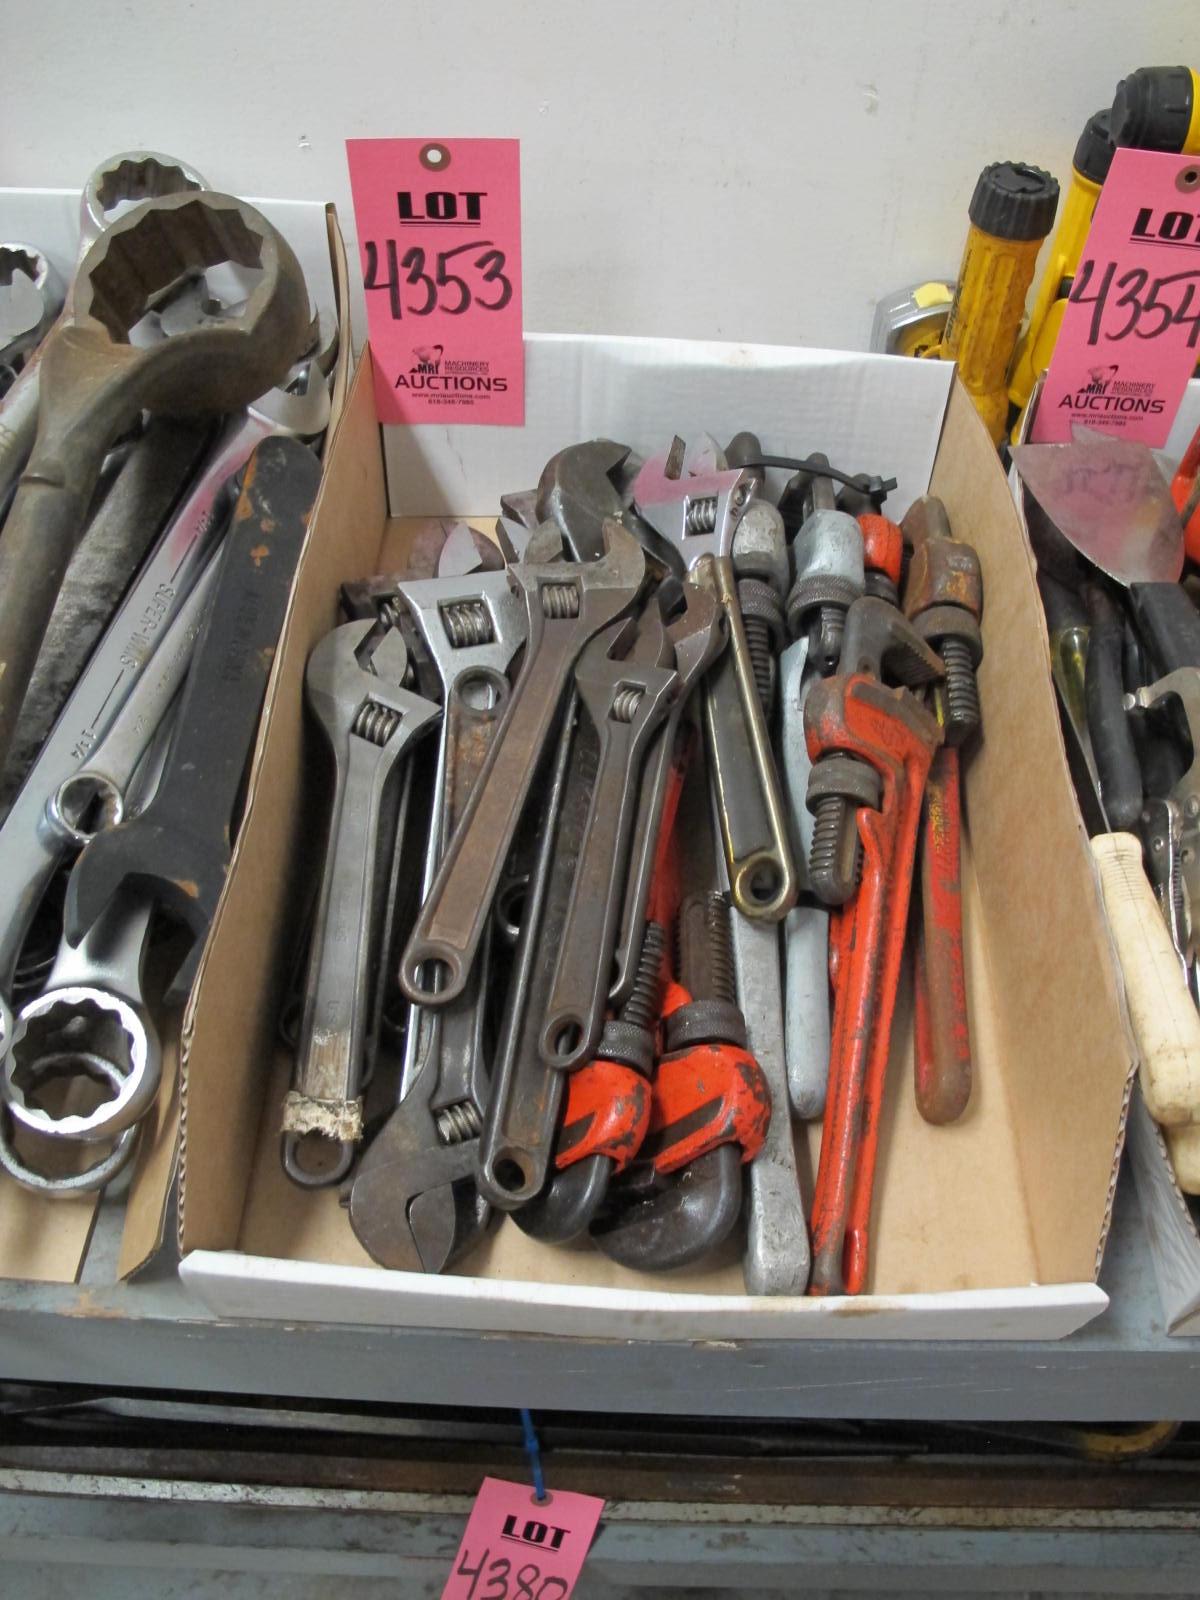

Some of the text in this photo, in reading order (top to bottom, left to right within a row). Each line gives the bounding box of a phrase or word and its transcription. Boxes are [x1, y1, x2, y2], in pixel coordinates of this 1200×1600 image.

[397, 191, 488, 220] LOT
[1131, 208, 1200, 243] LO
[364, 239, 513, 321] 4353
[1069, 259, 1200, 348] 4354
[395, 374, 508, 392] AUCTIONS
[1058, 394, 1166, 414] AUCTIONS
[501, 1514, 571, 1549] LOT
